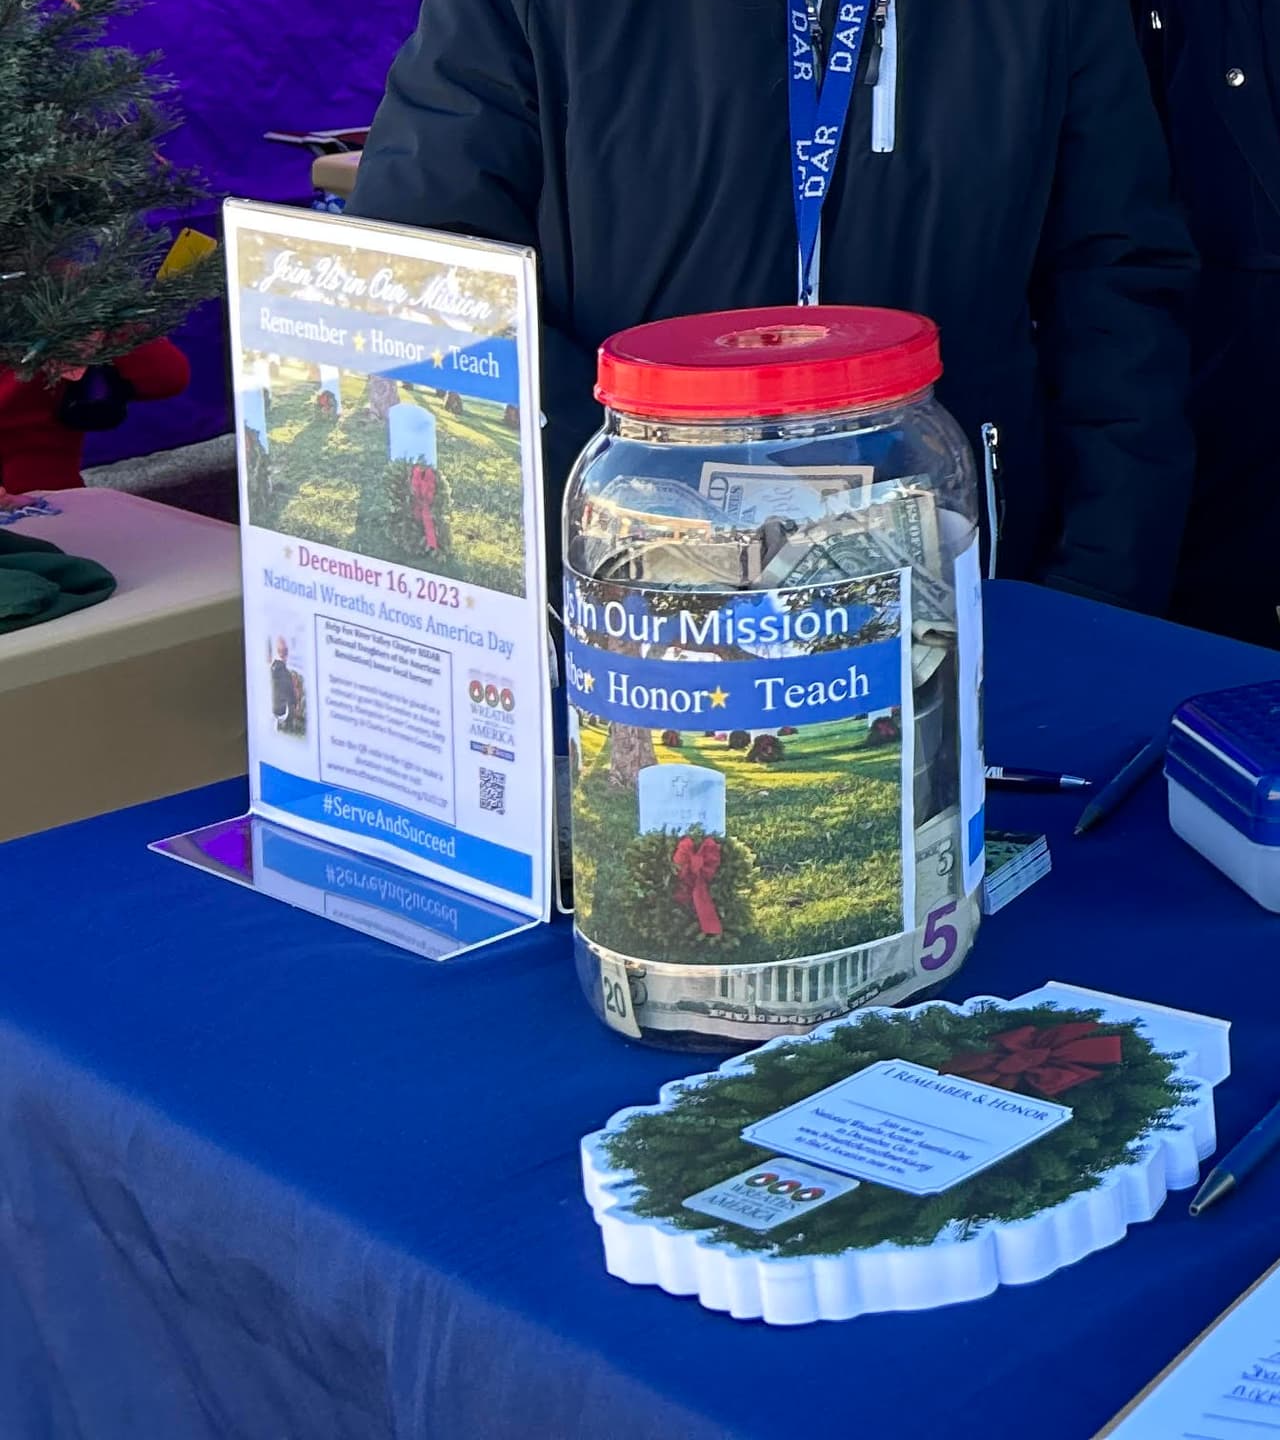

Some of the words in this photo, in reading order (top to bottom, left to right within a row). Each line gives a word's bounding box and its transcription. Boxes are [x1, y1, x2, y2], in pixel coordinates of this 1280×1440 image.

[791, 9, 813, 82] DAR
[830, 2, 865, 74] DAR
[804, 125, 838, 198] DAR
[254, 250, 312, 293] Join
[368, 268, 408, 305] Our
[409, 272, 492, 320] Mission
[260, 307, 347, 346] Remember
[371, 328, 425, 361] Honor
[450, 345, 500, 378] Teach
[298, 546, 382, 588] December
[387, 570, 412, 599] 16,
[416, 578, 461, 609] 2023
[264, 569, 318, 601] National
[320, 584, 376, 618] Wreaths
[378, 602, 422, 630] Across
[426, 616, 484, 648] America
[488, 631, 515, 660] Day
[604, 601, 667, 643] Our
[680, 605, 849, 646] Mission
[607, 670, 709, 714] Honor
[754, 664, 871, 711] Teach
[323, 792, 456, 858] #ServeAndSucceed
[920, 900, 958, 972] 5
[603, 981, 627, 1018] 20
[893, 1069, 970, 1101] REMEMBER
[972, 1094, 985, 1105] &
[988, 1098, 1049, 1122] HONOR
